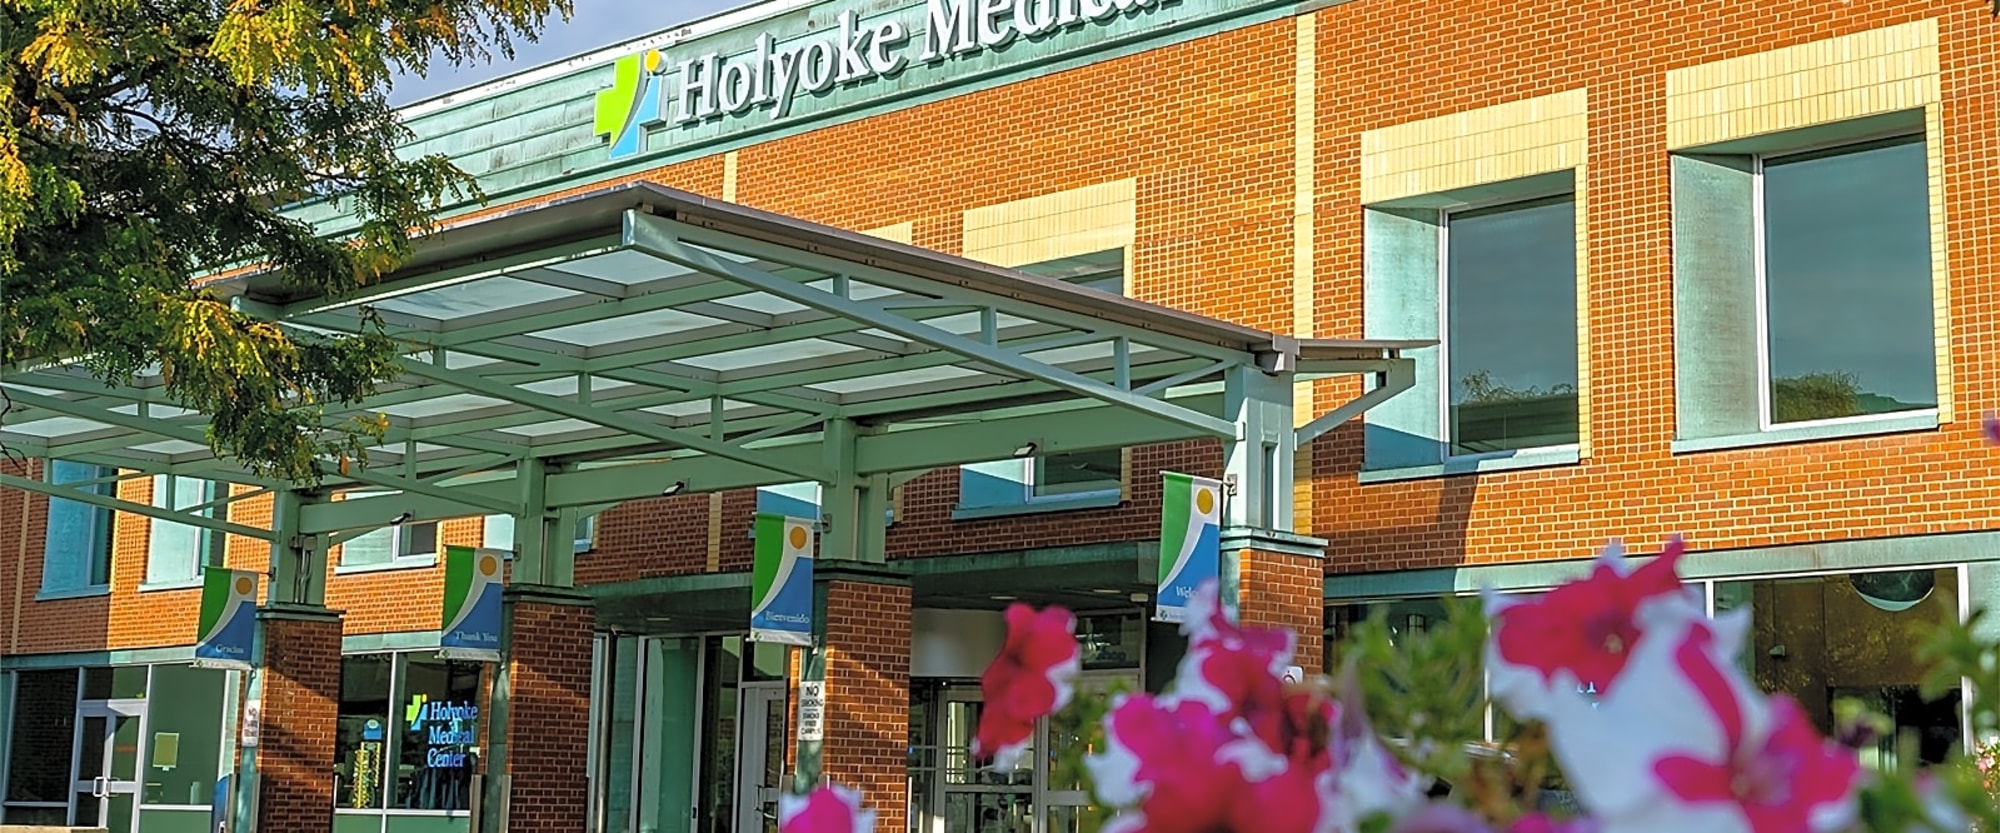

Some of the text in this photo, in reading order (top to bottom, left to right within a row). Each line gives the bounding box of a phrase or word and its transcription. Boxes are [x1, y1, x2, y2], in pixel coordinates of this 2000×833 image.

[673, 9, 909, 121] Holyoke
[765, 610, 810, 624] Bienvenido
[455, 631, 498, 642] Thank You
[805, 685, 820, 697] NO
[429, 700, 478, 722] Holyoke
[428, 725, 475, 745] Medical
[427, 747, 466, 767] Center
